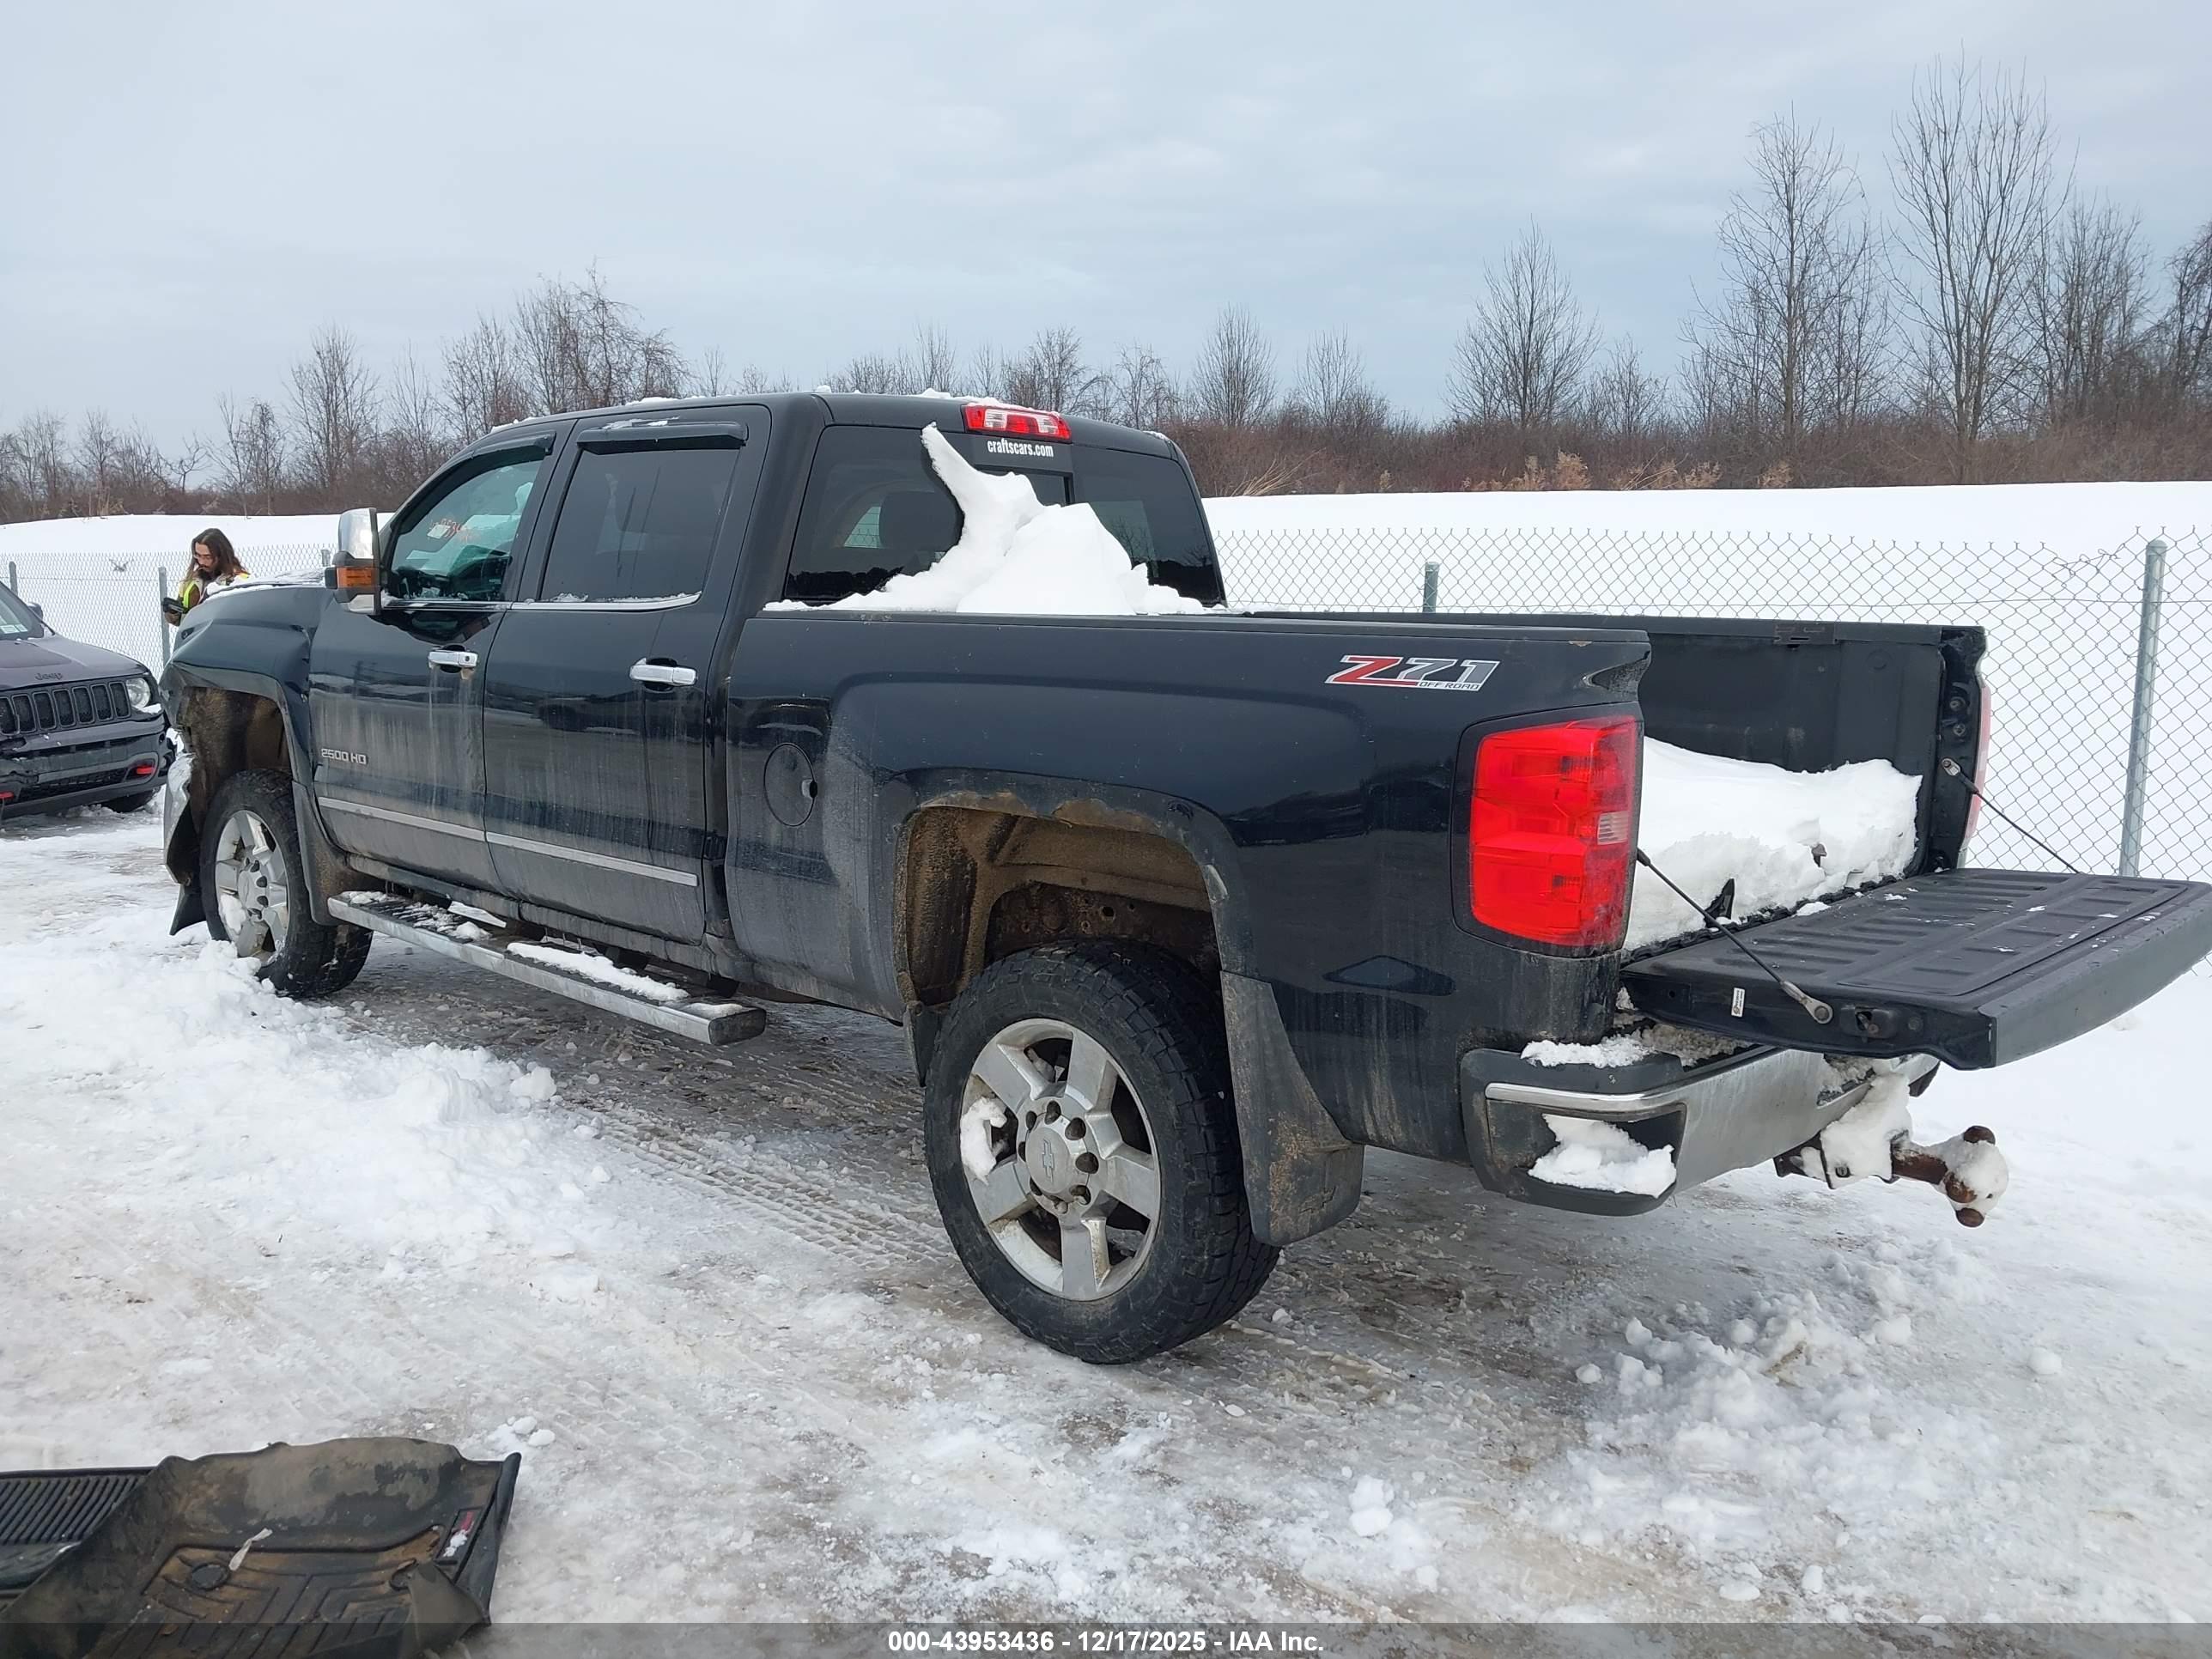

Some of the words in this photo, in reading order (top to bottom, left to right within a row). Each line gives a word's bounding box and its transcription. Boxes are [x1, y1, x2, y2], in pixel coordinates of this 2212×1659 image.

[987, 437, 1054, 458] craftscars.com
[34, 672, 63, 681] Jeep
[1324, 655, 1500, 690] Z71
[321, 748, 349, 762] 2500
[350, 752, 367, 764] HD
